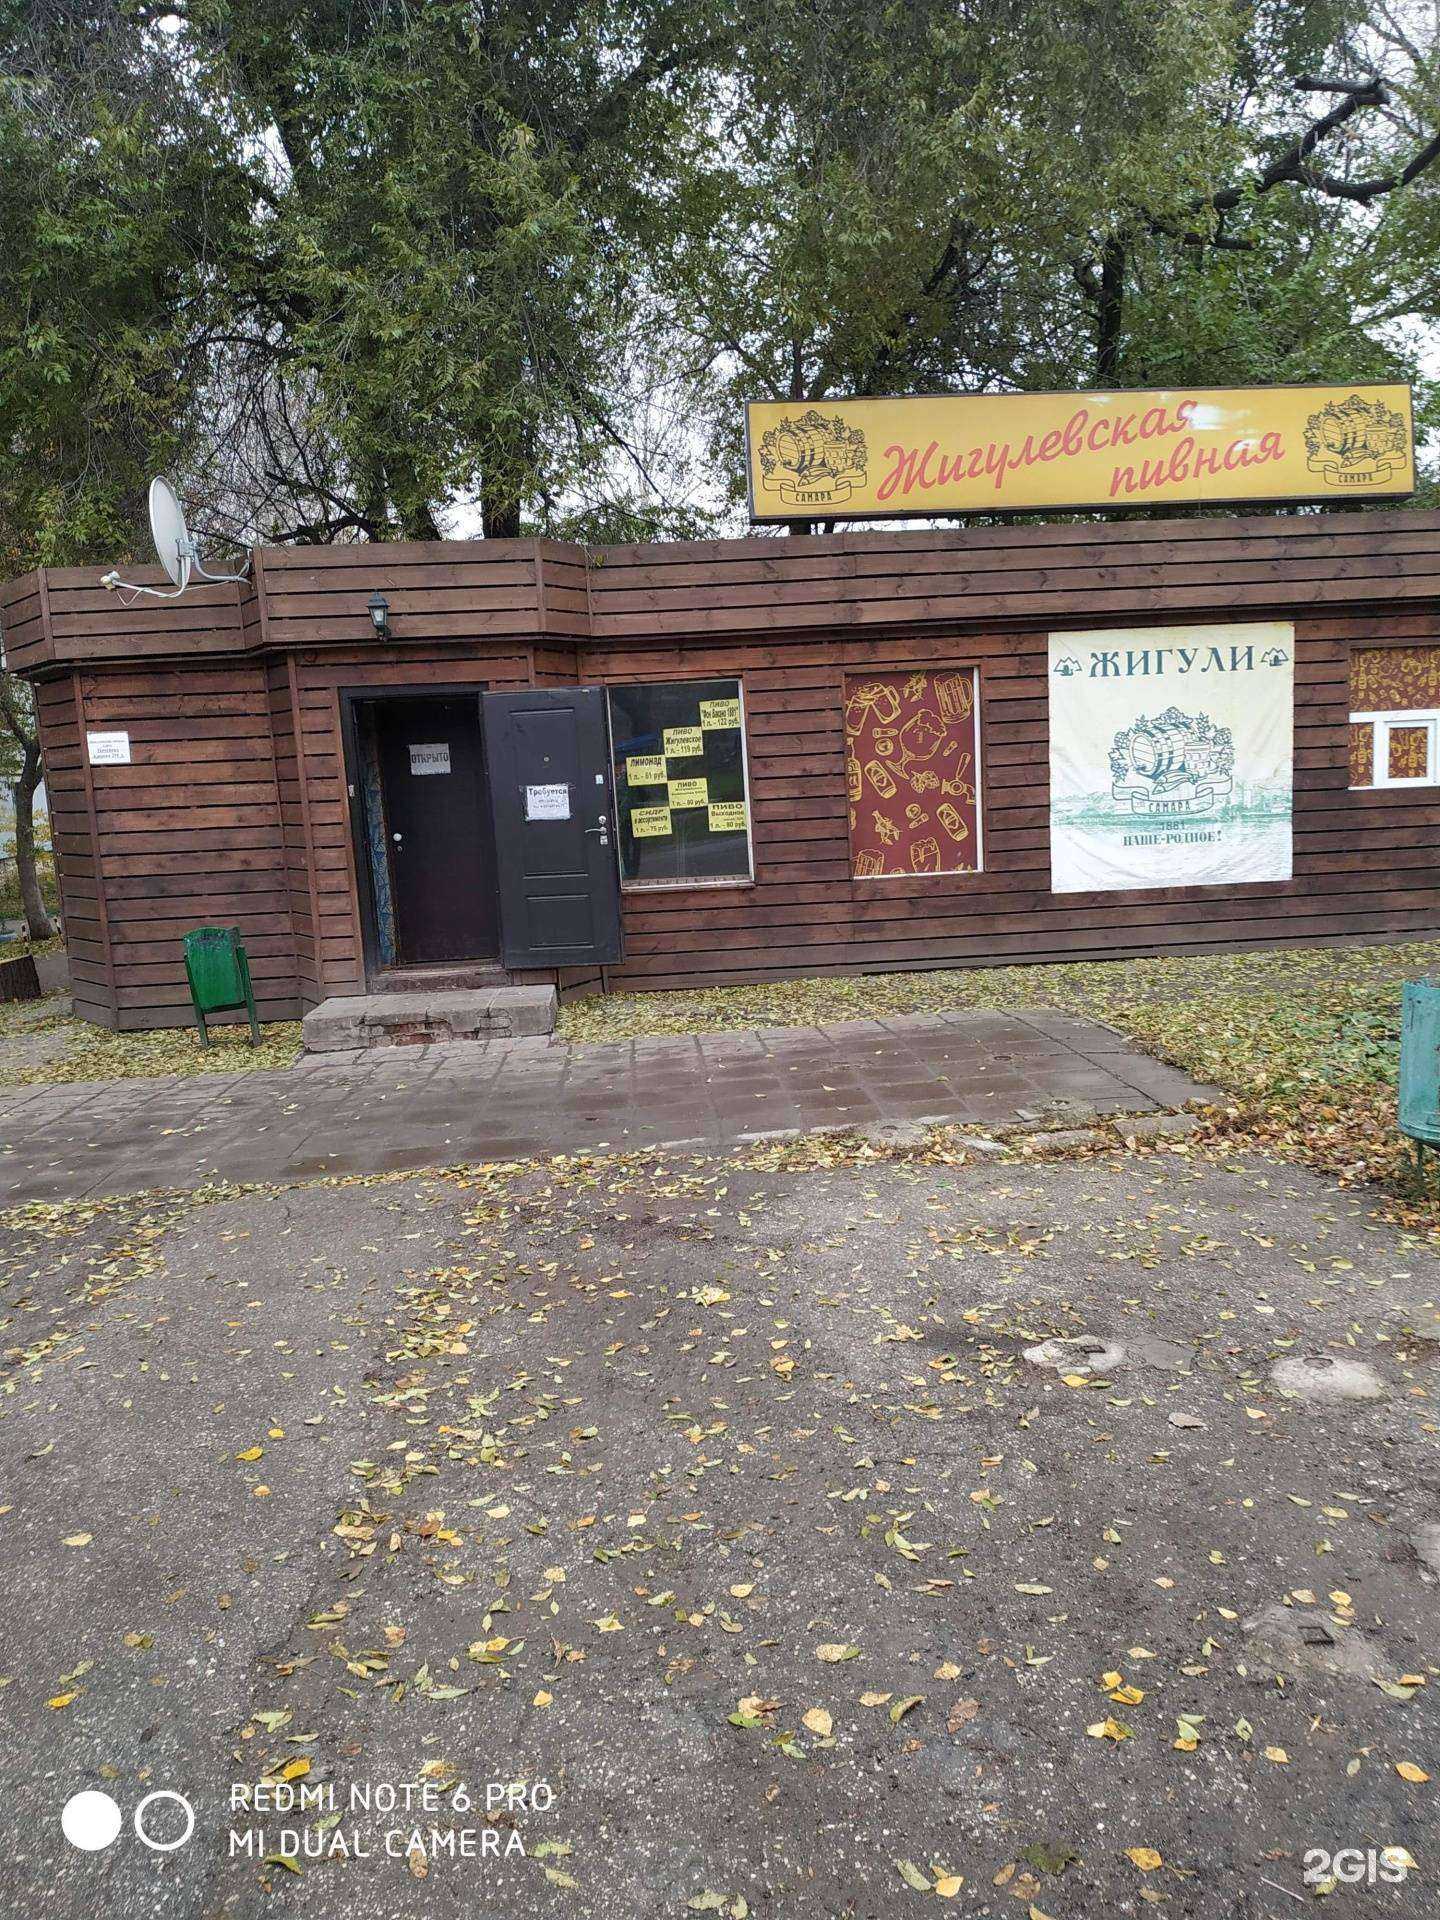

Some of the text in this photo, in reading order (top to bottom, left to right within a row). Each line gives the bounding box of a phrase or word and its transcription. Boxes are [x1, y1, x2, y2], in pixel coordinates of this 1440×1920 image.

[877, 400, 1197, 500] Жигулевская
[1110, 432, 1286, 496] пивная
[1338, 472, 1373, 483] САМАРА
[795, 491, 832, 502] САМАРА
[1089, 646, 1255, 678] ЖИГУЛИ
[677, 780, 698, 788] ПИВО
[528, 786, 568, 797] Требуется
[1149, 800, 1191, 813] САМАРА
